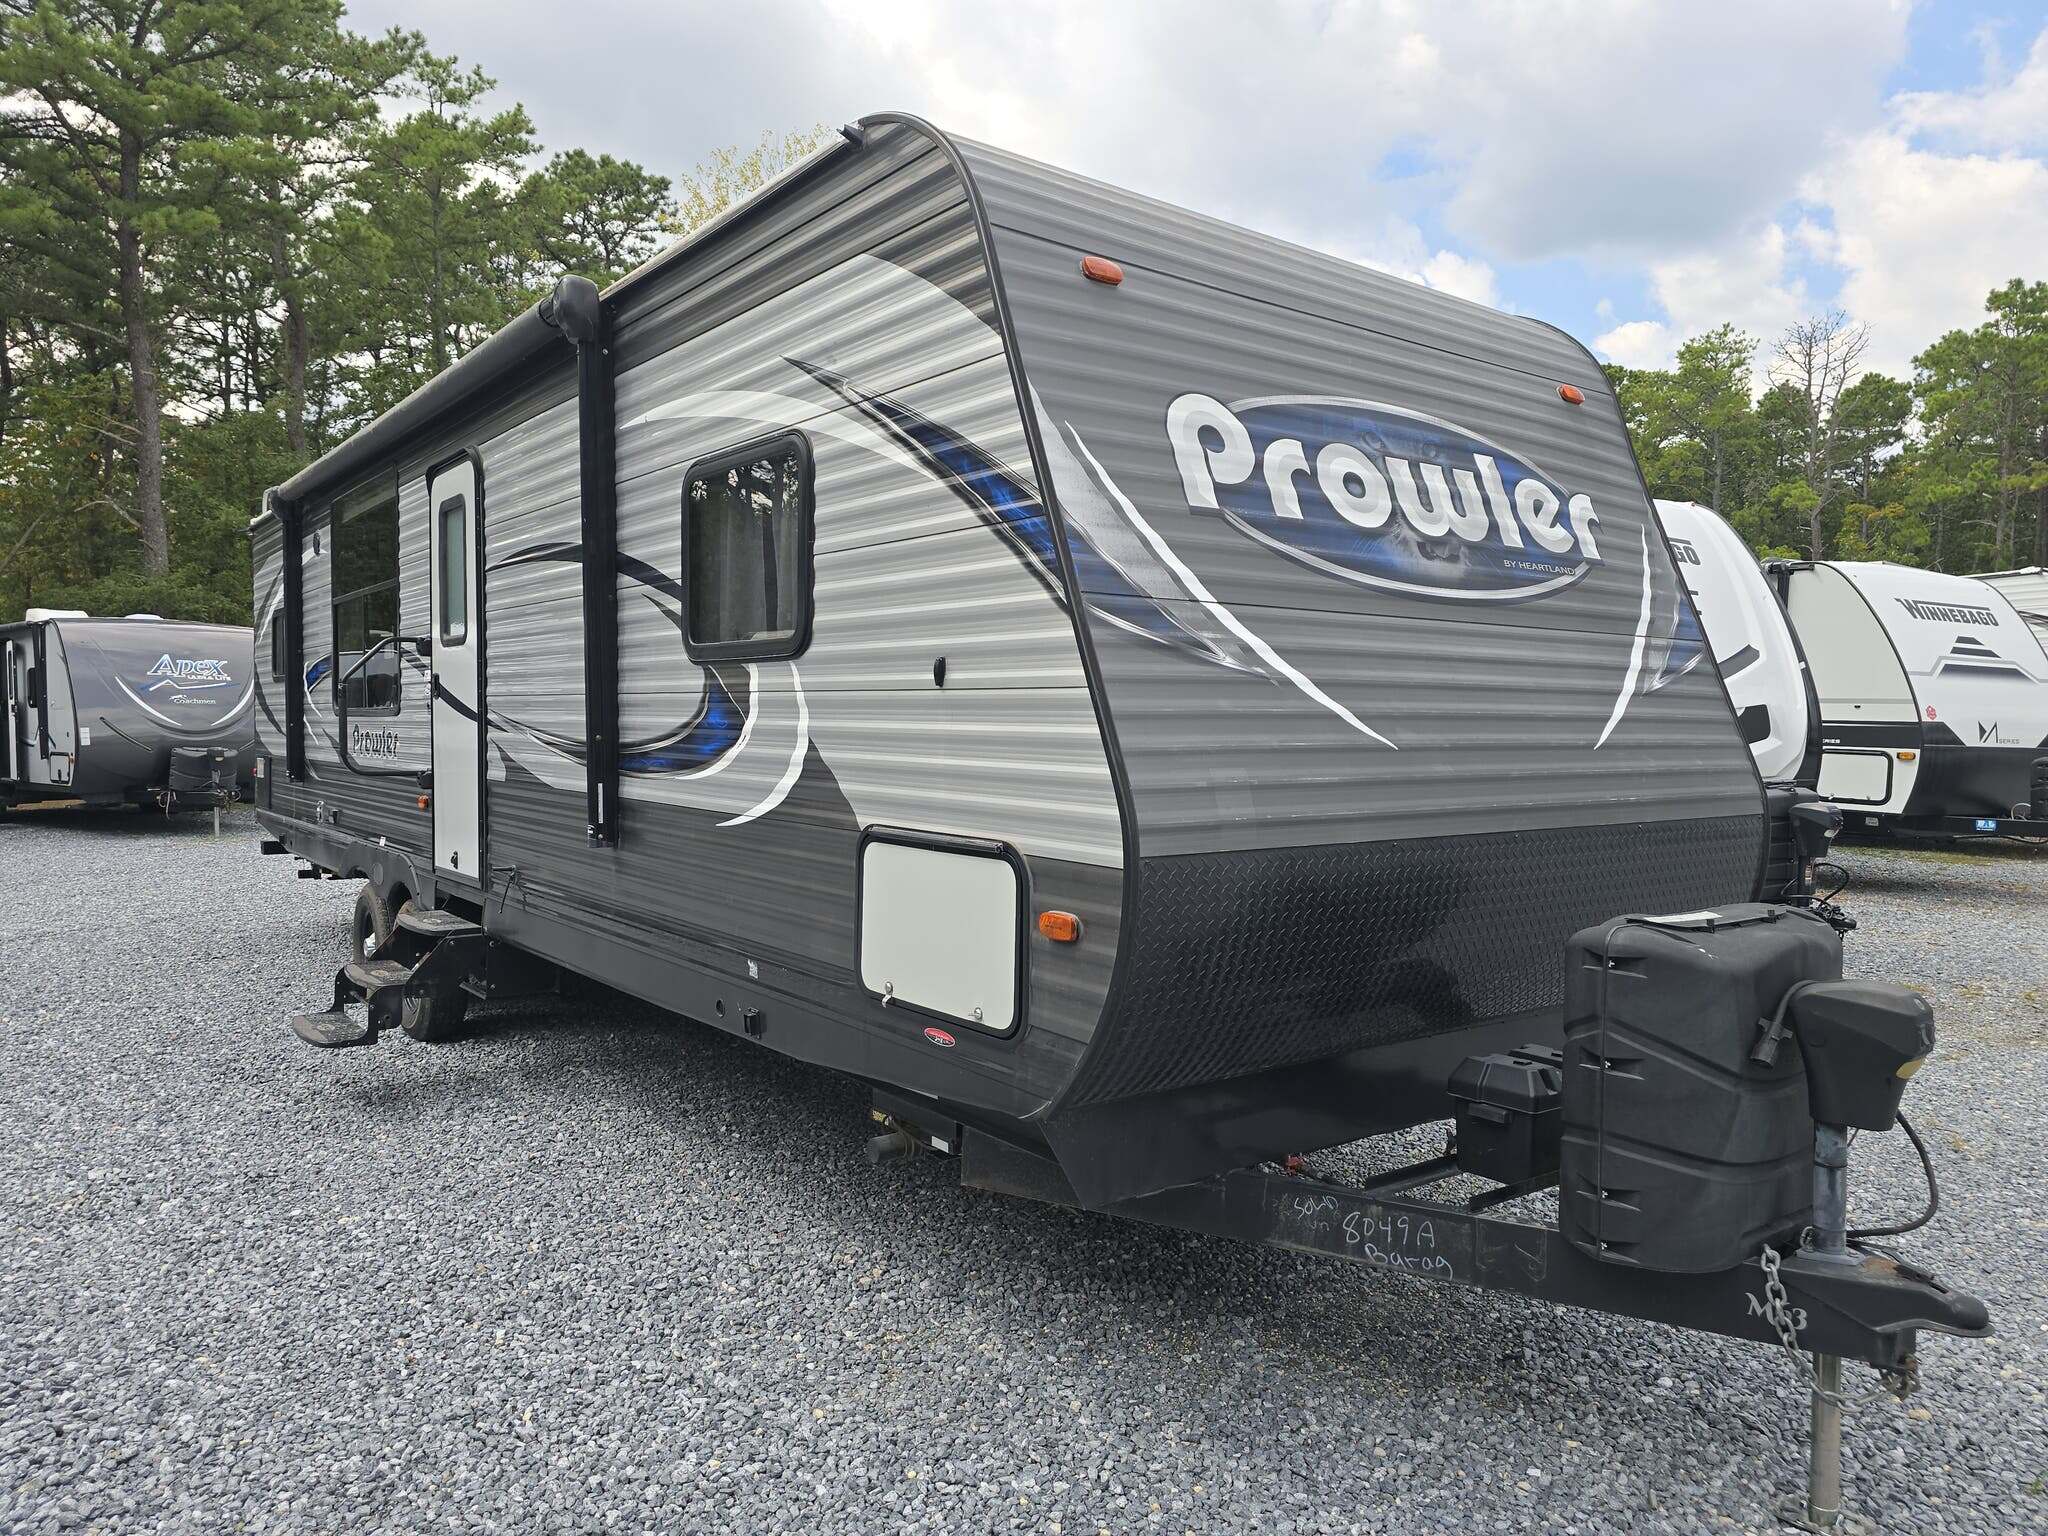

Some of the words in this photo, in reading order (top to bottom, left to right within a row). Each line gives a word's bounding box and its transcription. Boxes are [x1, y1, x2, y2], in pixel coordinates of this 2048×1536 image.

[1166, 393, 1602, 561] Prowler
[1503, 559, 1517, 569] BY
[1518, 561, 1576, 576] HEARTLAND
[1893, 598, 2000, 627] WINNEBAGO
[351, 723, 400, 758] Prowler
